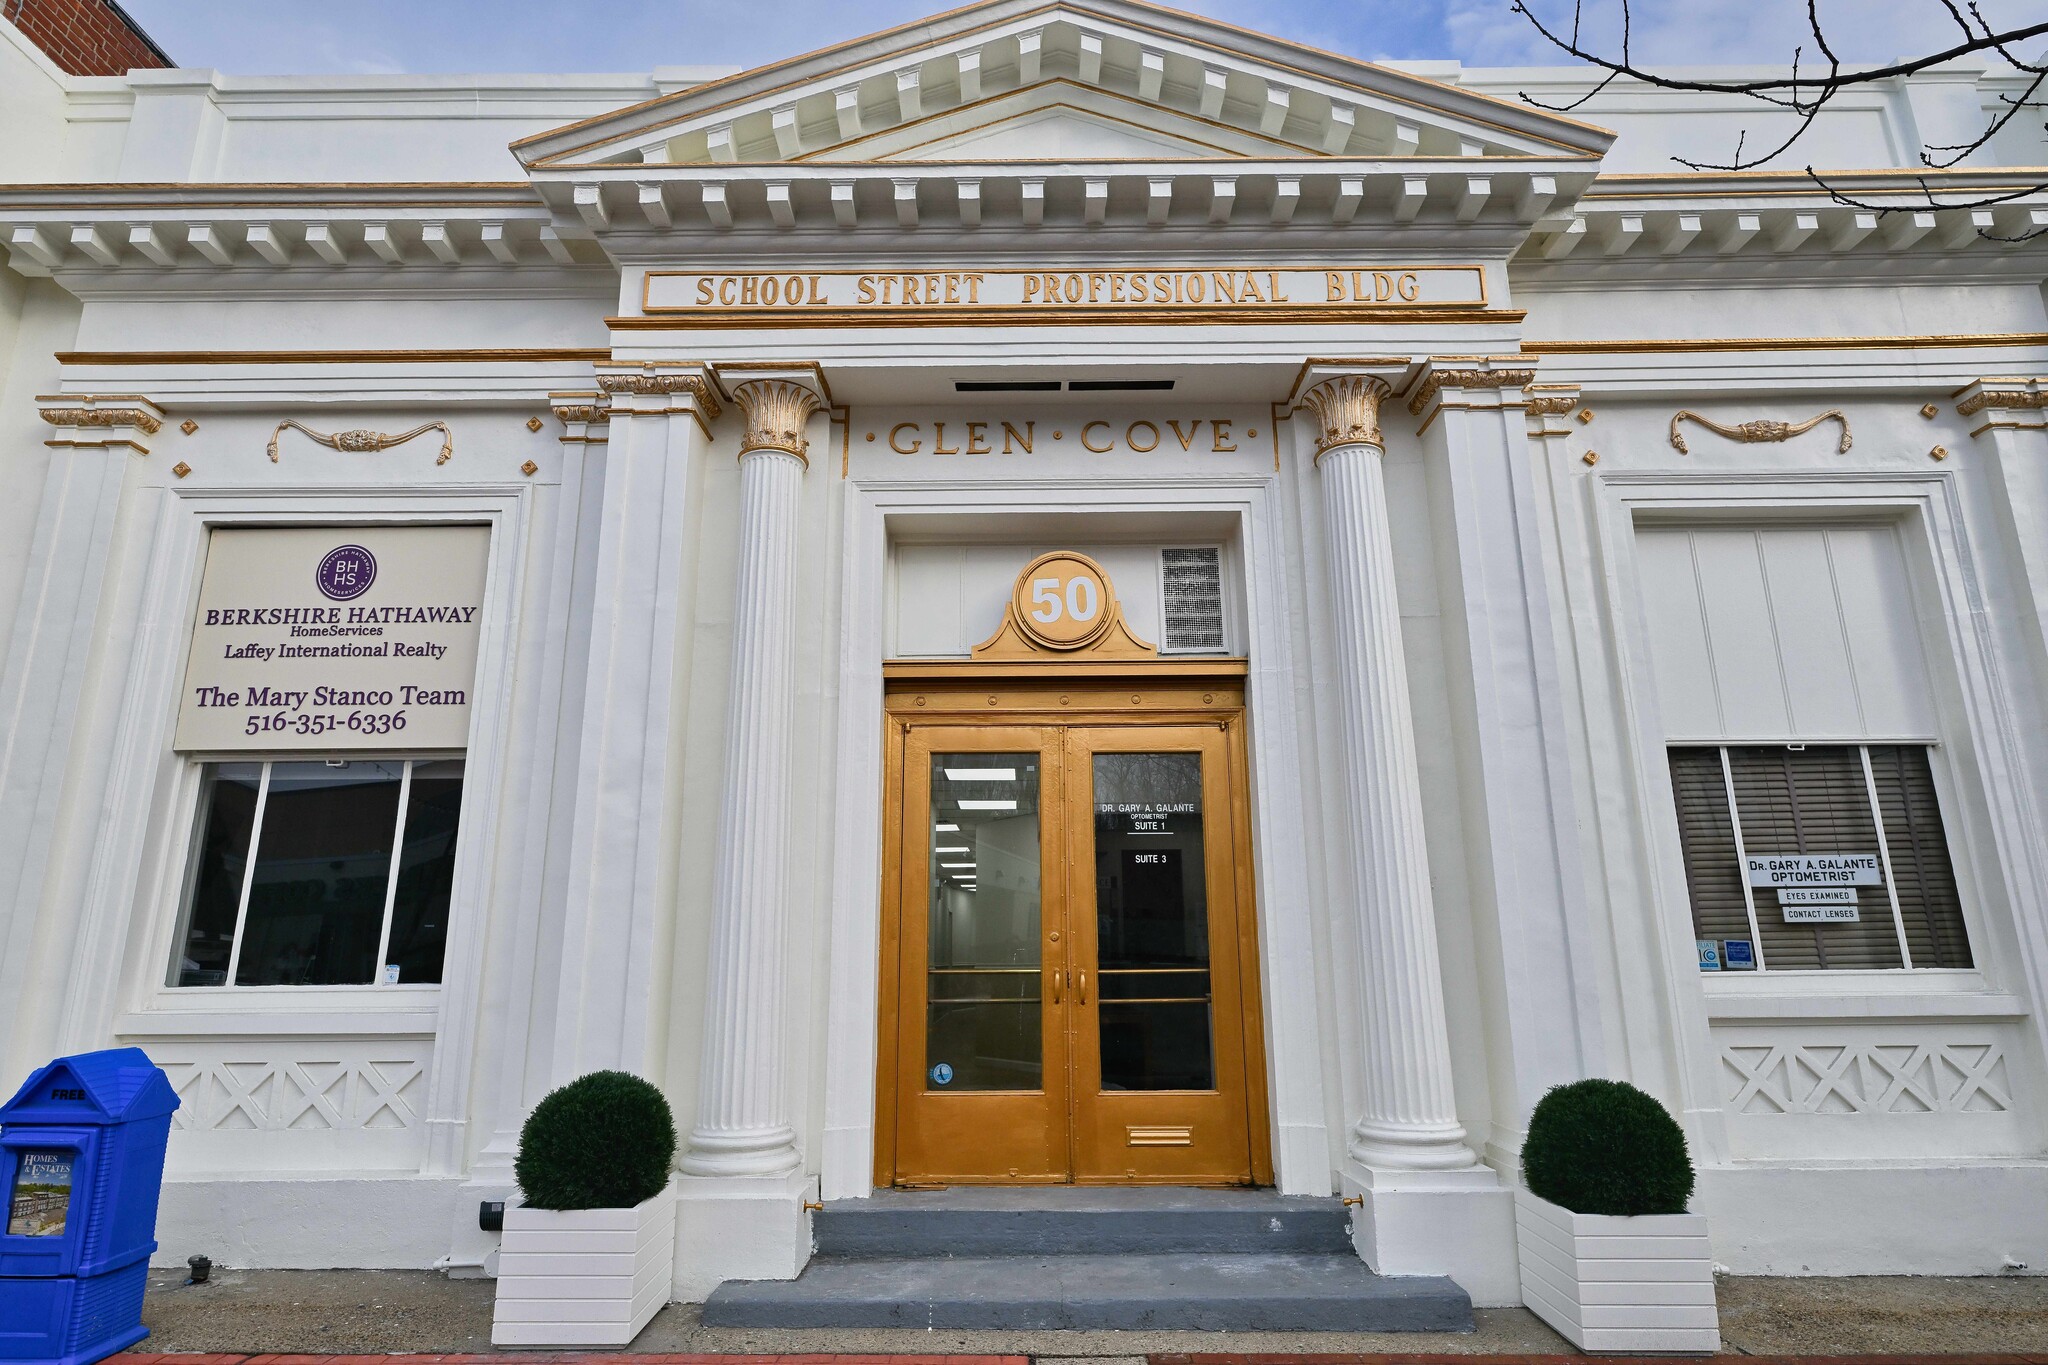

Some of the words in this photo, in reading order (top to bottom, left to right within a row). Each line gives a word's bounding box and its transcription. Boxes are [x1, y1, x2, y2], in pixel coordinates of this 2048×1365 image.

[695, 275, 828, 306] SCHOOL
[857, 274, 984, 305] STREET
[1022, 270, 1289, 304] PROFESSIONAL
[1325, 271, 1421, 302] BLDG
[888, 421, 1036, 454] GLEN
[1081, 420, 1238, 453] COVE
[336, 560, 359, 573] BH
[334, 573, 357, 586] HS
[1031, 576, 1098, 623] 50
[204, 607, 341, 626] BERKSHIRE
[346, 606, 477, 624] HATHAWAY
[290, 625, 384, 637] HomeServices
[224, 643, 275, 661] Laffey
[278, 642, 389, 658] International
[393, 641, 448, 660] Realty
[196, 686, 239, 707] The
[245, 686, 308, 711] Mary
[313, 685, 393, 706] Stanco
[399, 685, 466, 706] Team
[244, 709, 408, 735] 516-351-6336
[1102, 804, 1116, 813] DR.
[1118, 804, 1141, 812] GARY
[1145, 804, 1153, 812] A.
[1156, 803, 1195, 812] GALANTE
[1134, 821, 1158, 830] SUITE
[1161, 822, 1165, 830] 1
[1135, 854, 1159, 863] SUITE
[1161, 855, 1167, 863] 3
[1769, 860, 1800, 871] GARY
[1806, 860, 1817, 870] A.
[1819, 858, 1876, 869] GALANTE
[1771, 871, 1856, 882] OPTOMETRIST
[1786, 892, 1806, 900] EYES
[1810, 892, 1850, 900] EXAMINED
[1788, 910, 1821, 918] CONTACT
[1825, 910, 1855, 918] LENSES
[51, 1089, 87, 1101] FREE
